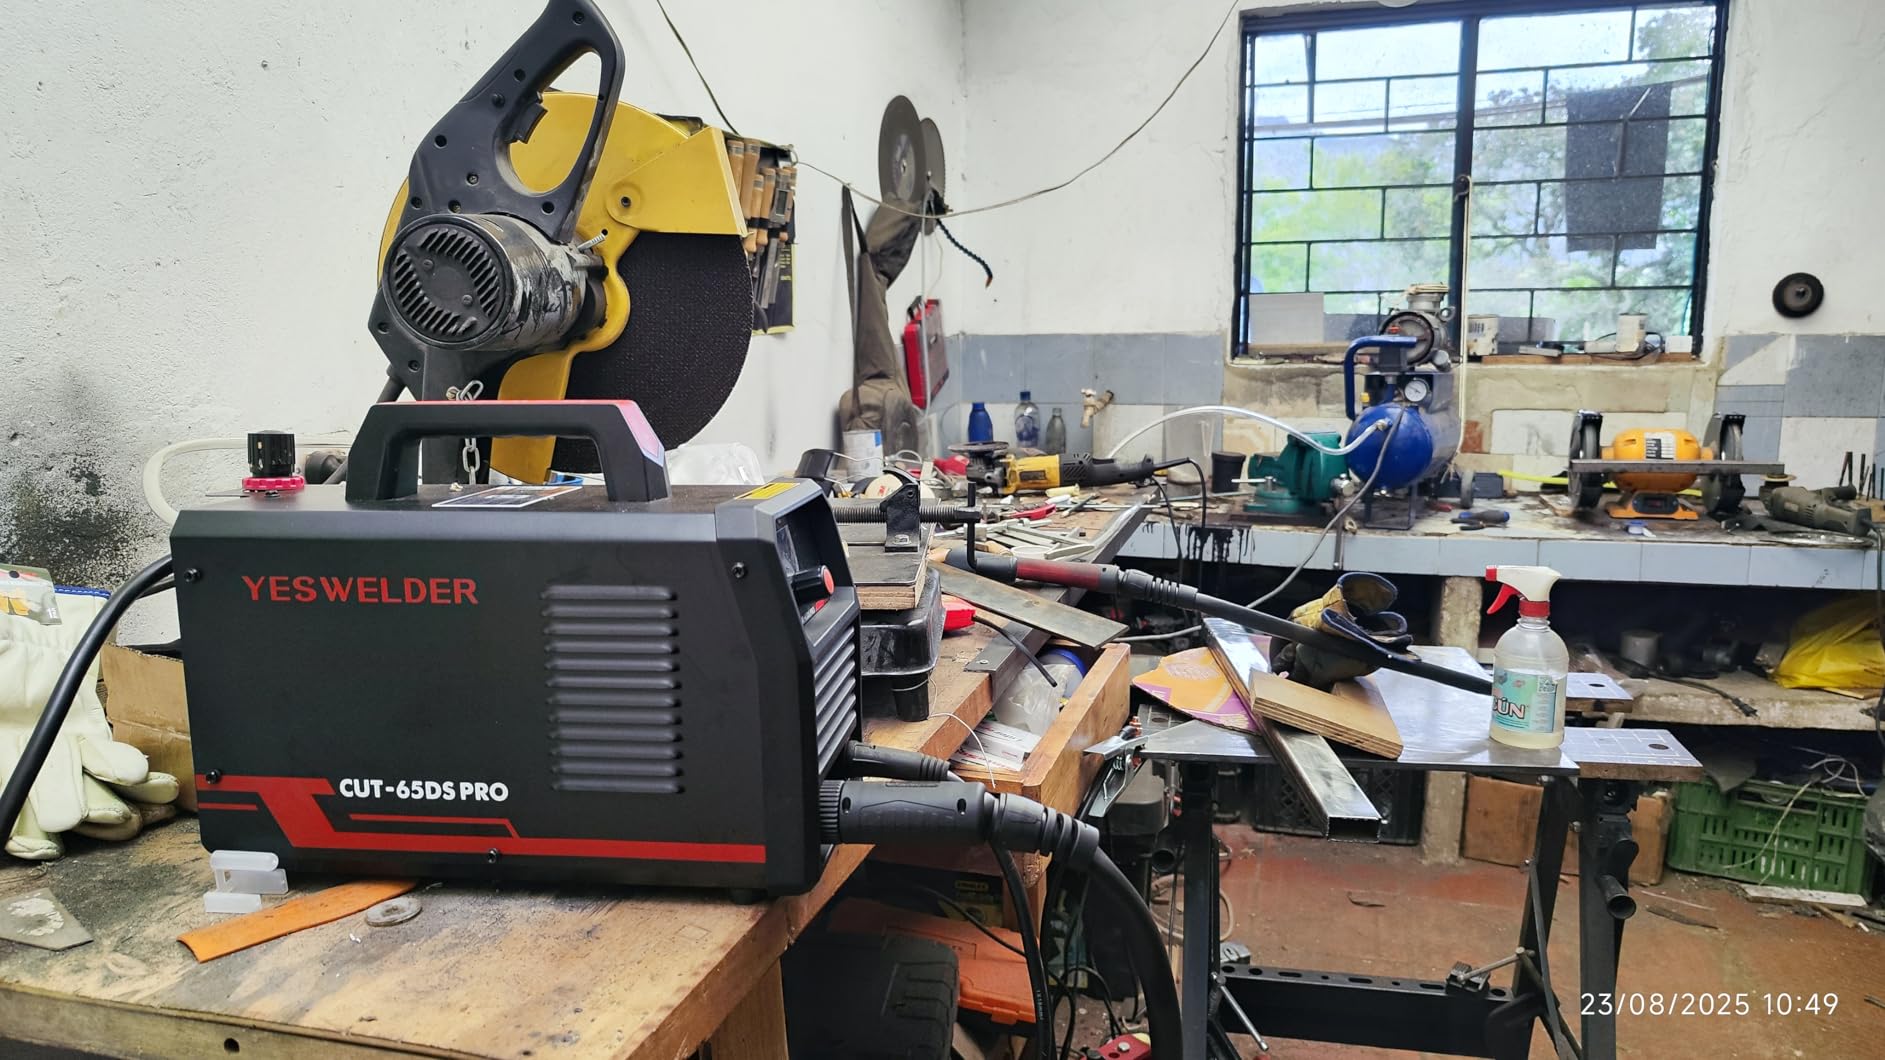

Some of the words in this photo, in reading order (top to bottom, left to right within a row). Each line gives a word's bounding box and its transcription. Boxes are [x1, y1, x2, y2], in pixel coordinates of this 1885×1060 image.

[241, 575, 479, 605] YESWELDER
[338, 778, 456, 801] CUT-65DS
[460, 781, 509, 802] PRO
